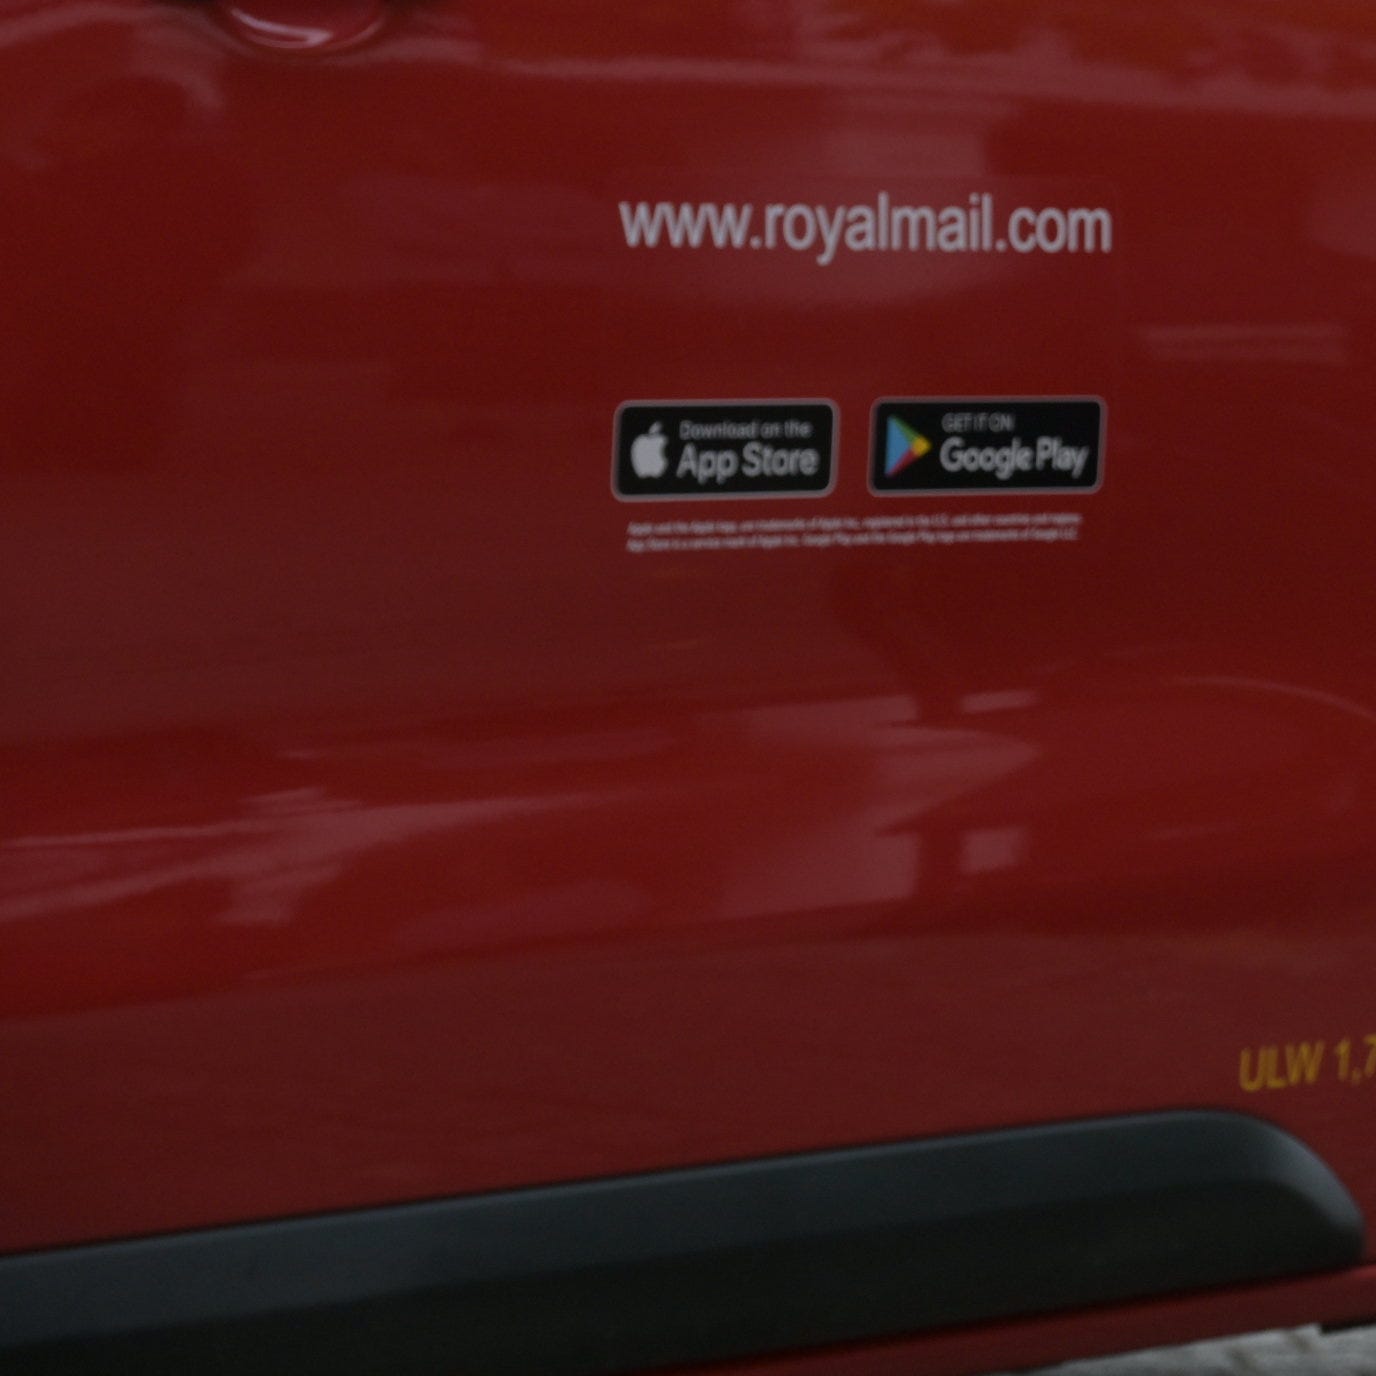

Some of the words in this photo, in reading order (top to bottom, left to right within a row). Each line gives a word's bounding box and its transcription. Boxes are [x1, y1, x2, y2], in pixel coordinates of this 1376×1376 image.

[618, 191, 1113, 267] www.royalmail.com
[679, 418, 756, 441] Download
[760, 422, 781, 439] on
[785, 419, 813, 438] the
[675, 440, 739, 485] App
[742, 440, 821, 477] Store
[939, 436, 1033, 481] Google
[1036, 435, 1091, 479] Play
[1239, 1040, 1325, 1092] ULW
